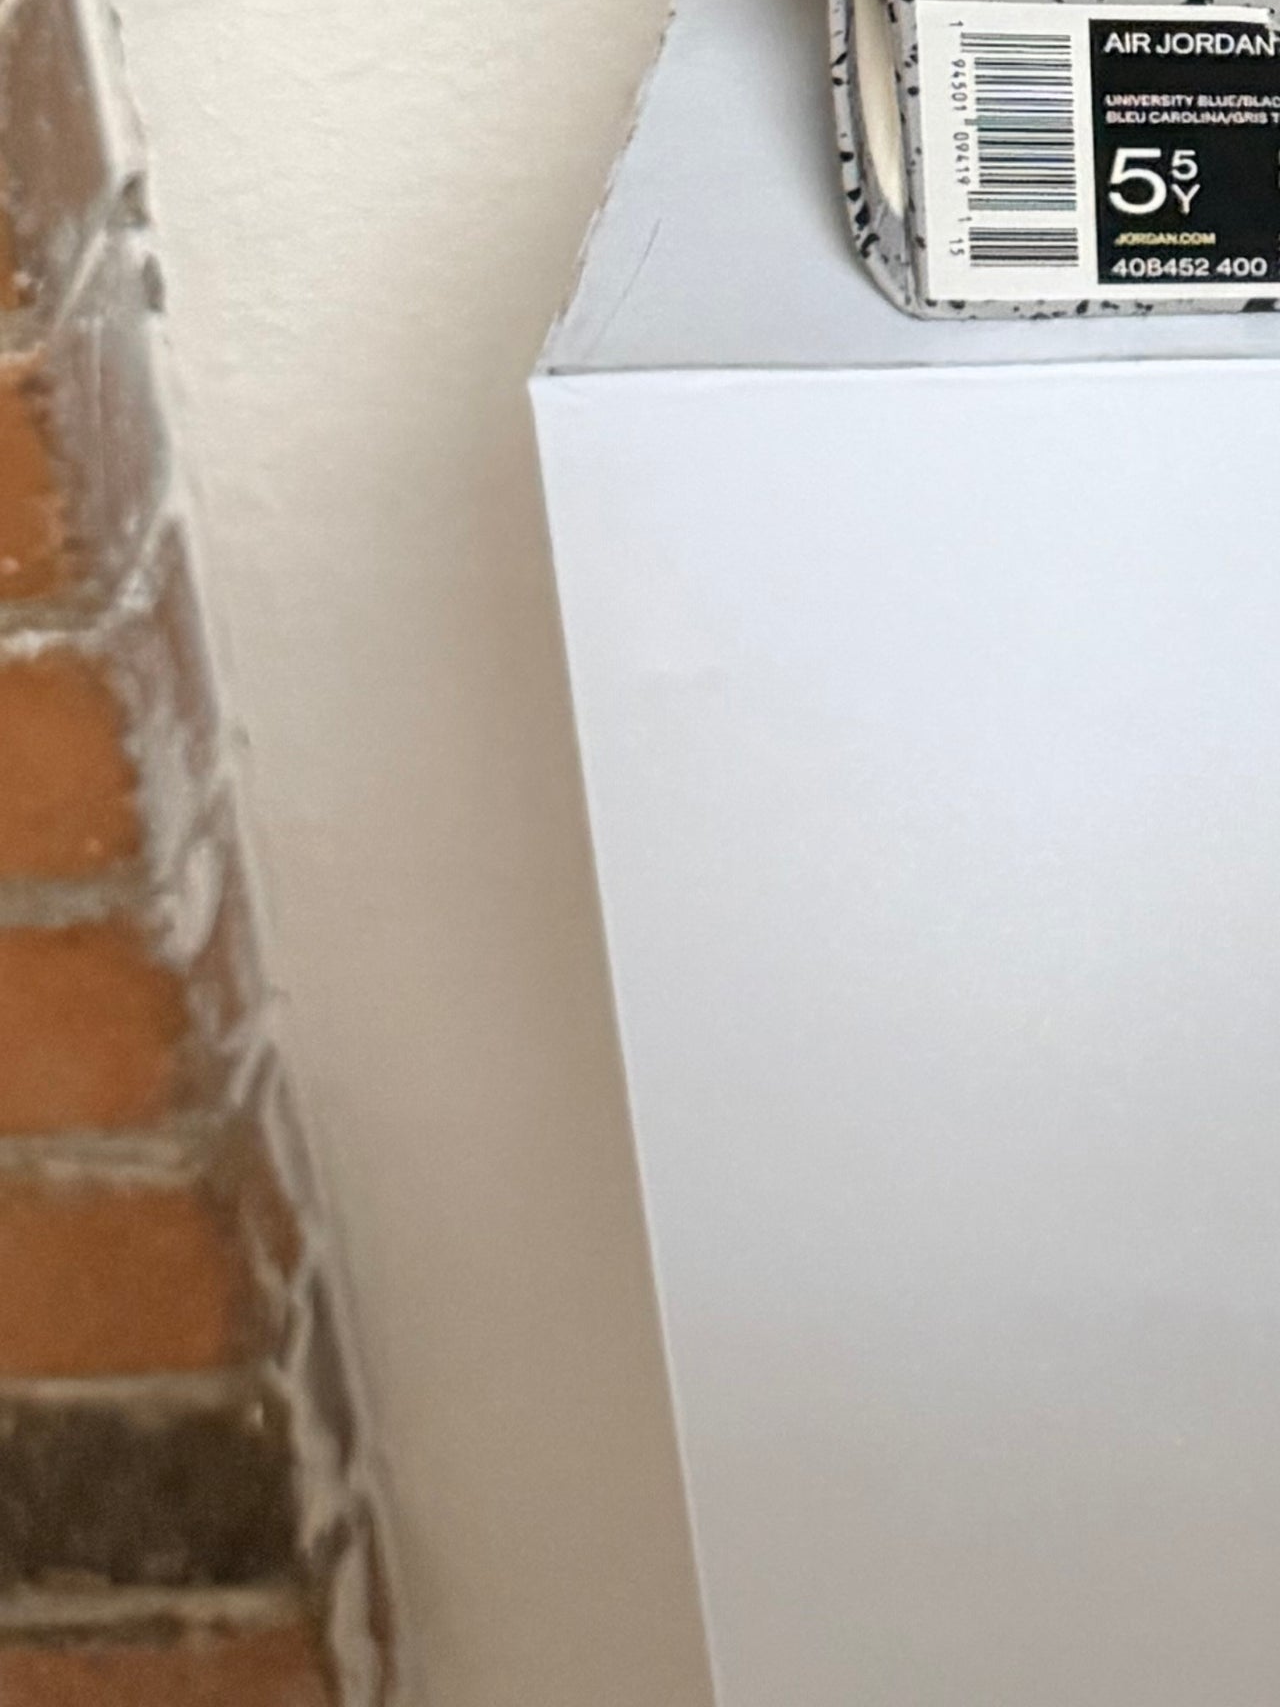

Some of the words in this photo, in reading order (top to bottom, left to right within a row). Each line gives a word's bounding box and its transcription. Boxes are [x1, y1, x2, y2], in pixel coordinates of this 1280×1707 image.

[1103, 32, 1152, 54] AIR
[1155, 33, 1275, 57] JORDAN
[1105, 95, 1194, 108] UNIVERSITY
[1106, 111, 1147, 125] BLEU
[1108, 147, 1168, 215] 5
[1114, 232, 1217, 246] JORDAN.COM
[1111, 257, 1210, 277] 408452
[1215, 257, 1268, 276] 400
